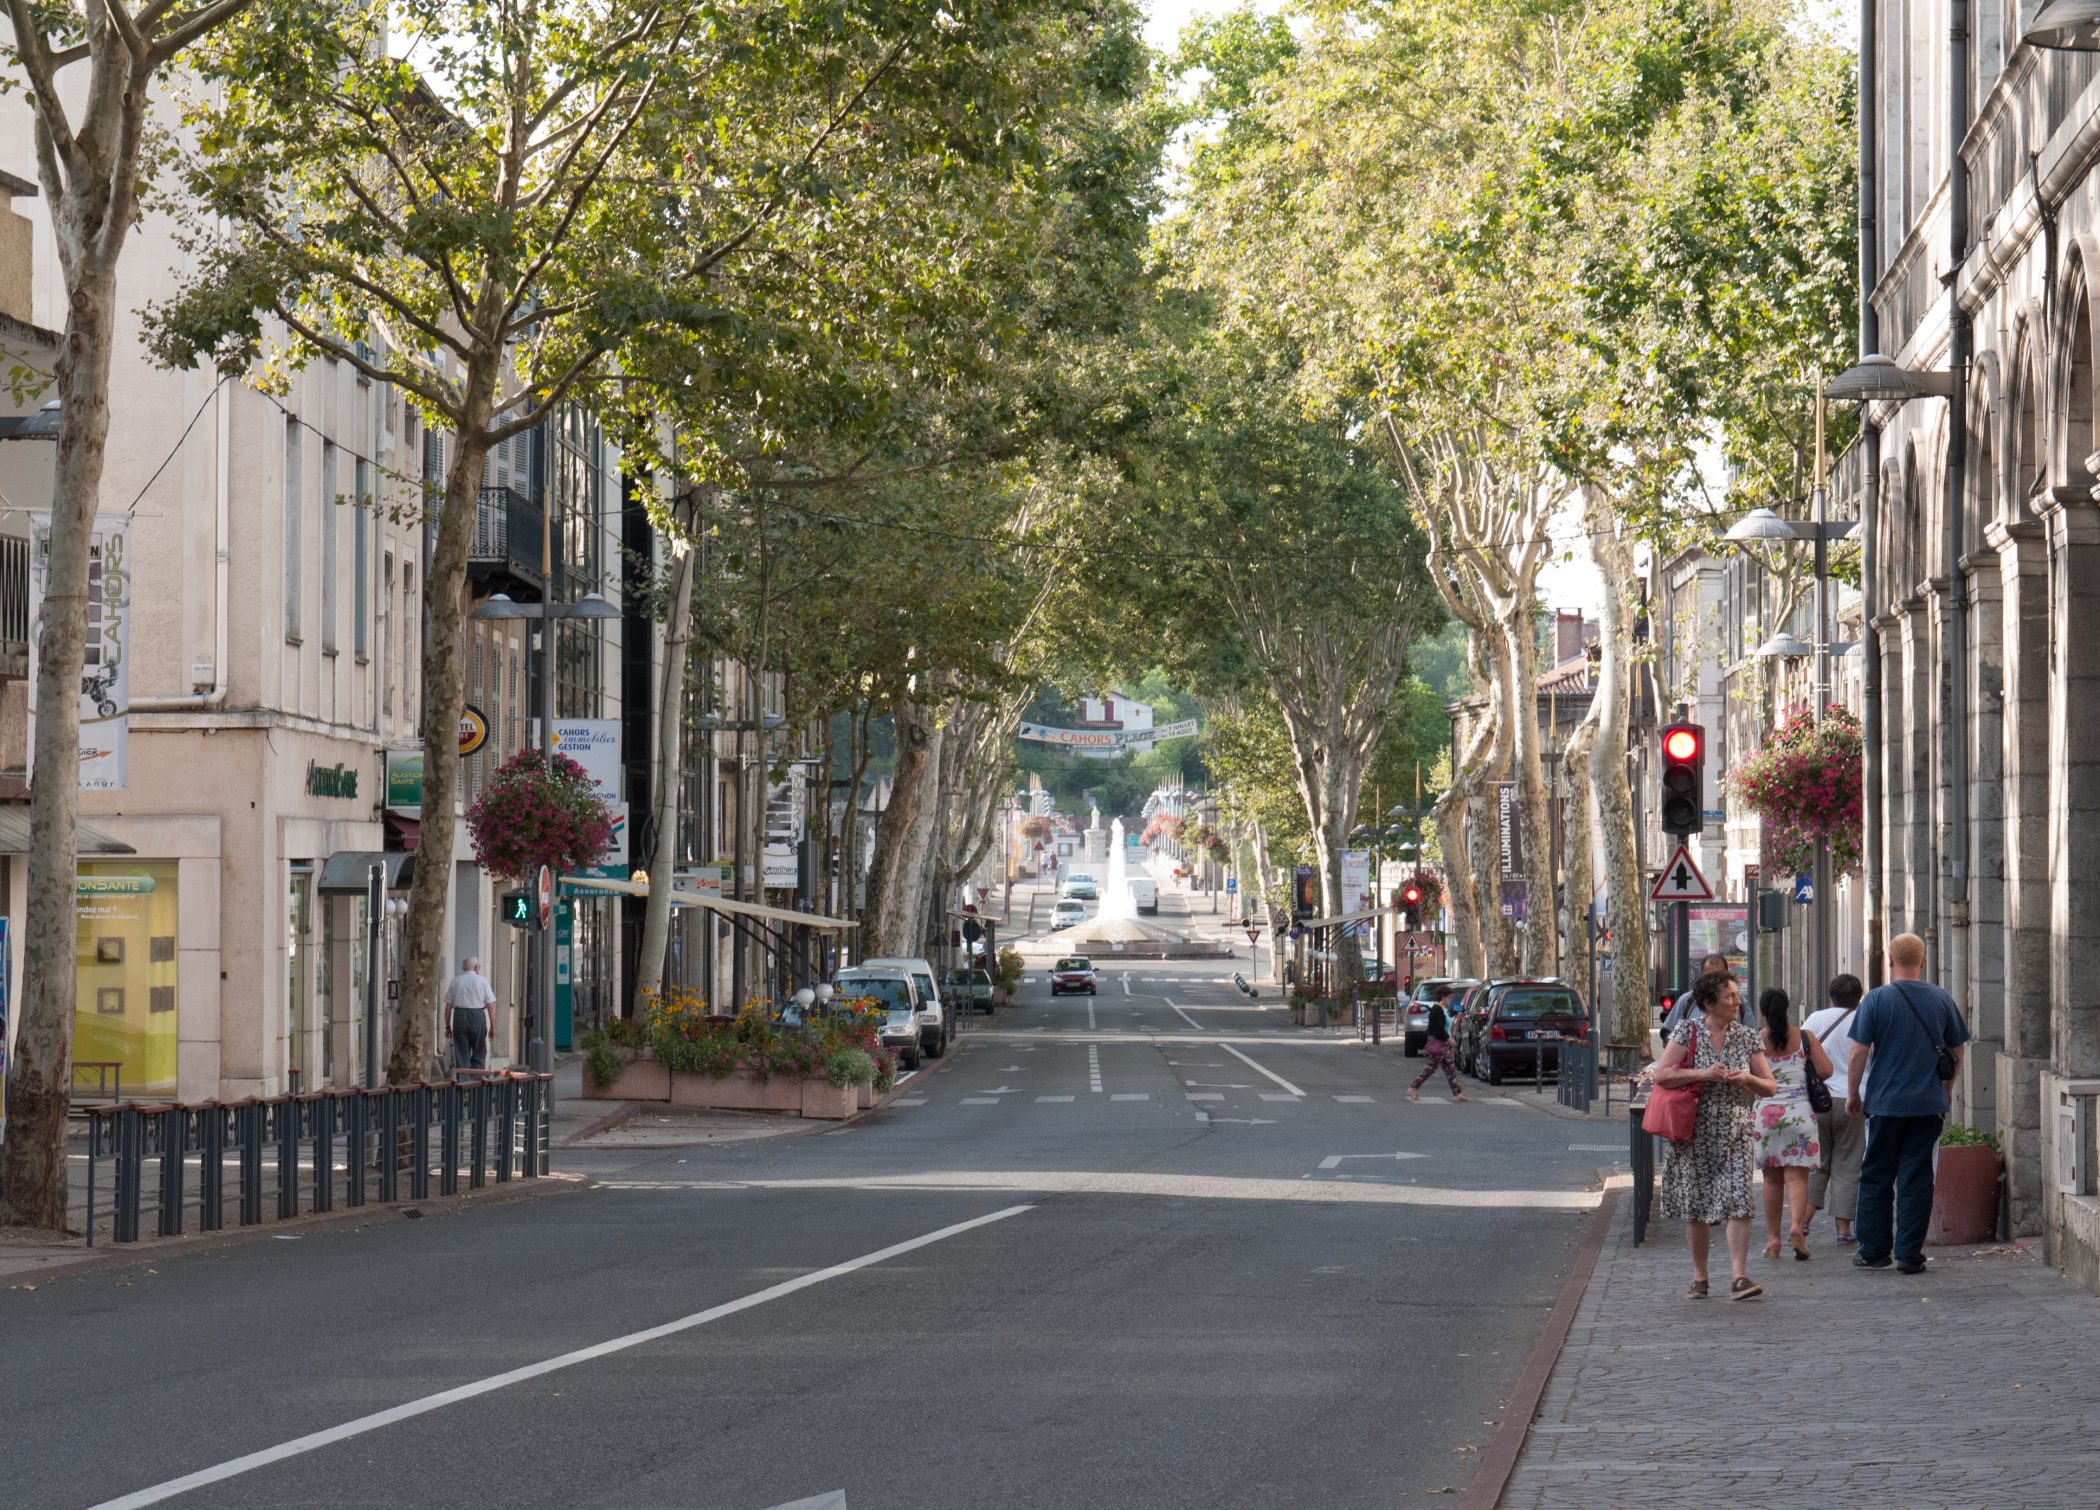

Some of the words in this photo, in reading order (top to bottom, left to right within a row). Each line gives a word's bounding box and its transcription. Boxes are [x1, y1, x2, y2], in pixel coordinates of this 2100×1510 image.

[103, 533, 123, 666] CAHORS
[563, 731, 616, 743] immobilier
[1061, 731, 1112, 745] CAHORS
[1500, 787, 1511, 873] ILLUMINATIONS
